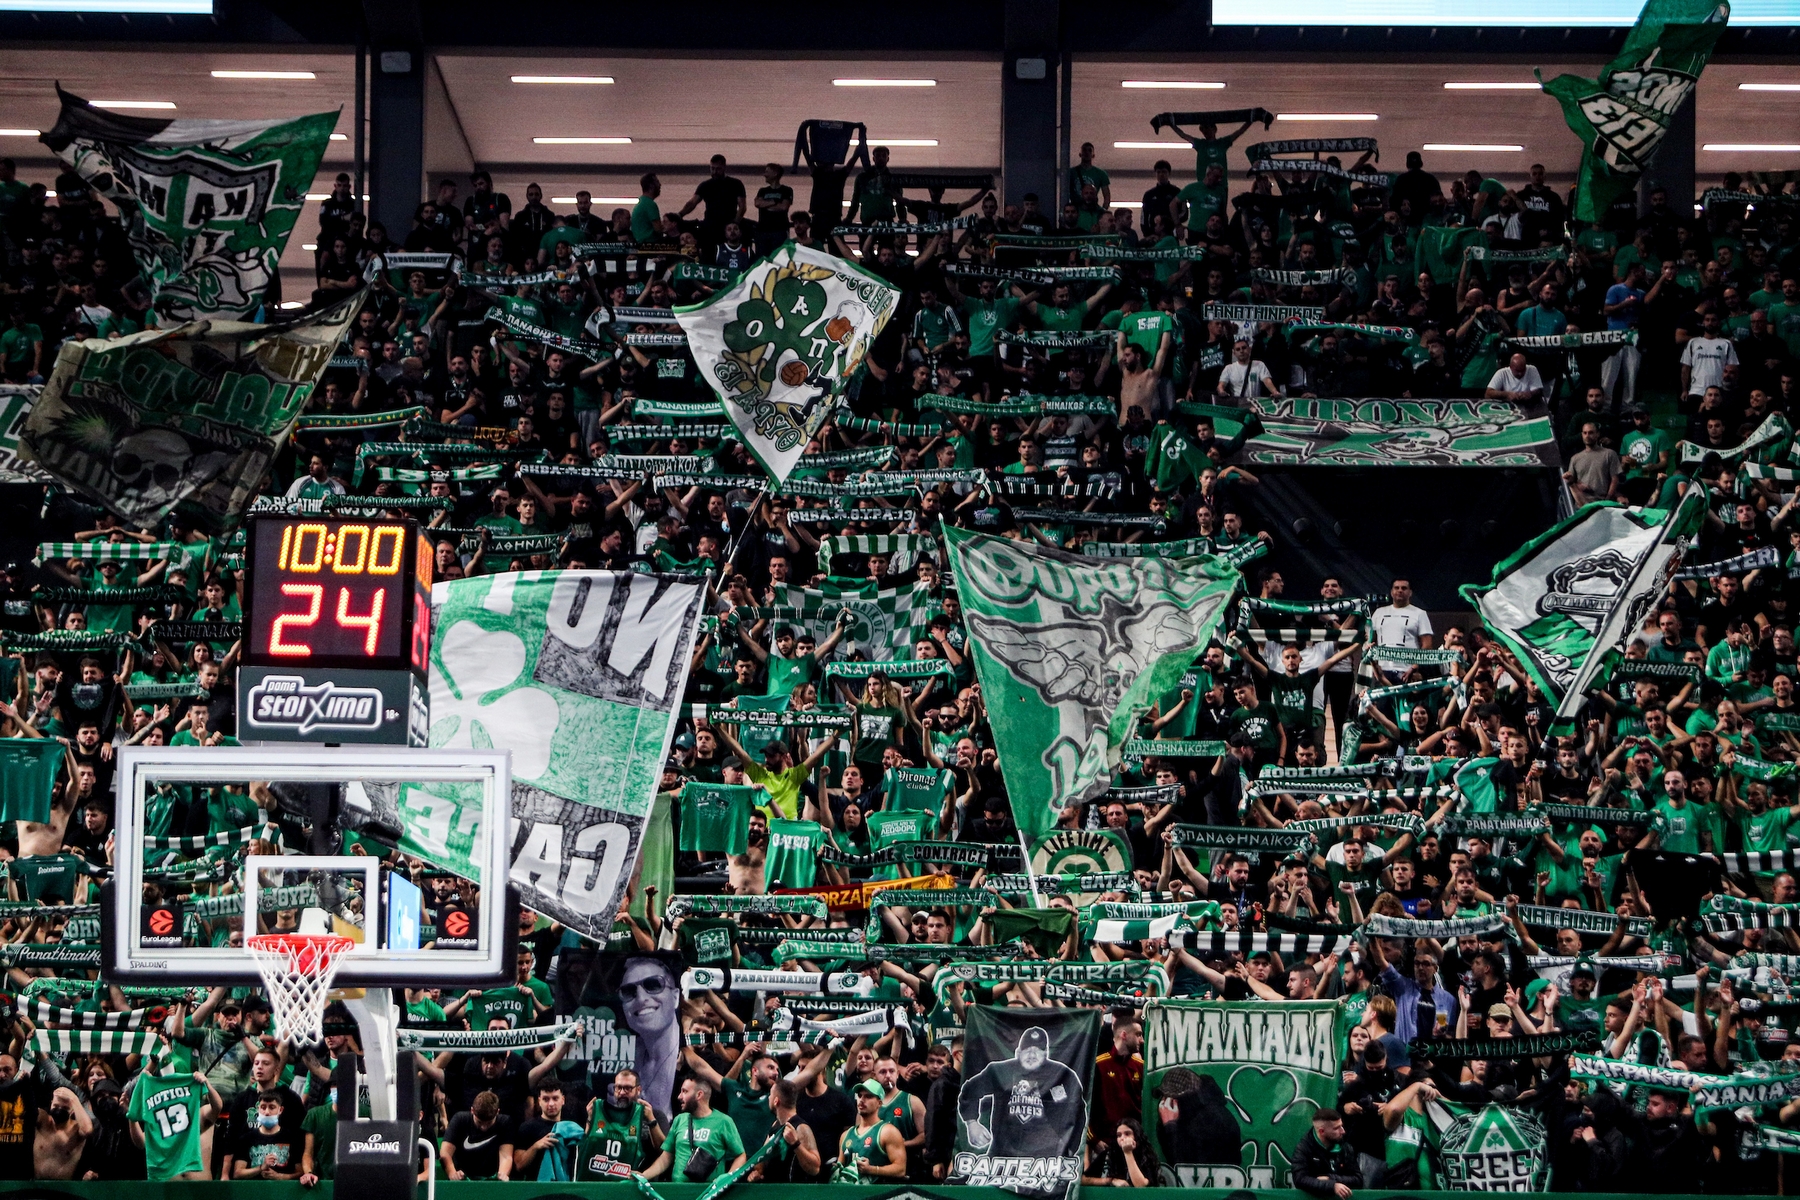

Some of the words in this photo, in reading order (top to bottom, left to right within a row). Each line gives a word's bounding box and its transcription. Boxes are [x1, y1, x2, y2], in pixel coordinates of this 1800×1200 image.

[681, 263, 729, 282] GATE
[656, 402, 722, 411] PANATHINAIK
[1249, 397, 1523, 424] VIRONAS
[278, 523, 406, 575] 10:00
[268, 583, 385, 656] 24
[1617, 662, 1697, 677] ΑΘΗΝΑΪΚΟΣ
[266, 680, 297, 692] pame
[385, 709, 400, 719] 18+
[749, 711, 778, 724] CLUB
[1185, 830, 1301, 847] ΠΑΝΑΘΗΝΑΪΚΟΣ
[197, 895, 245, 918] ΑΘΗΝ
[1105, 904, 1120, 919] SK
[1122, 904, 1152, 919] RAPID
[62, 917, 101, 939] ΑΘΗΝ
[142, 934, 183, 944] EuroLeague
[437, 936, 478, 945] EuroLeague
[129, 959, 169, 971] SPALDING
[734, 973, 818, 985] PANATHINAIKOS
[560, 1034, 636, 1061] ΑΡΩΝ
[1148, 1008, 1336, 1076] ΑΜΑΛΙΑΔΑ
[587, 1061, 636, 1074] 4/12/22
[1575, 1056, 1721, 1089] NAFPAKTOS
[155, 1103, 190, 1139] 13
[349, 1141, 400, 1154] SPALDING
[605, 1139, 622, 1157] 10
[957, 1153, 1079, 1179] ΒΑΓΓΕΛΗΣ
